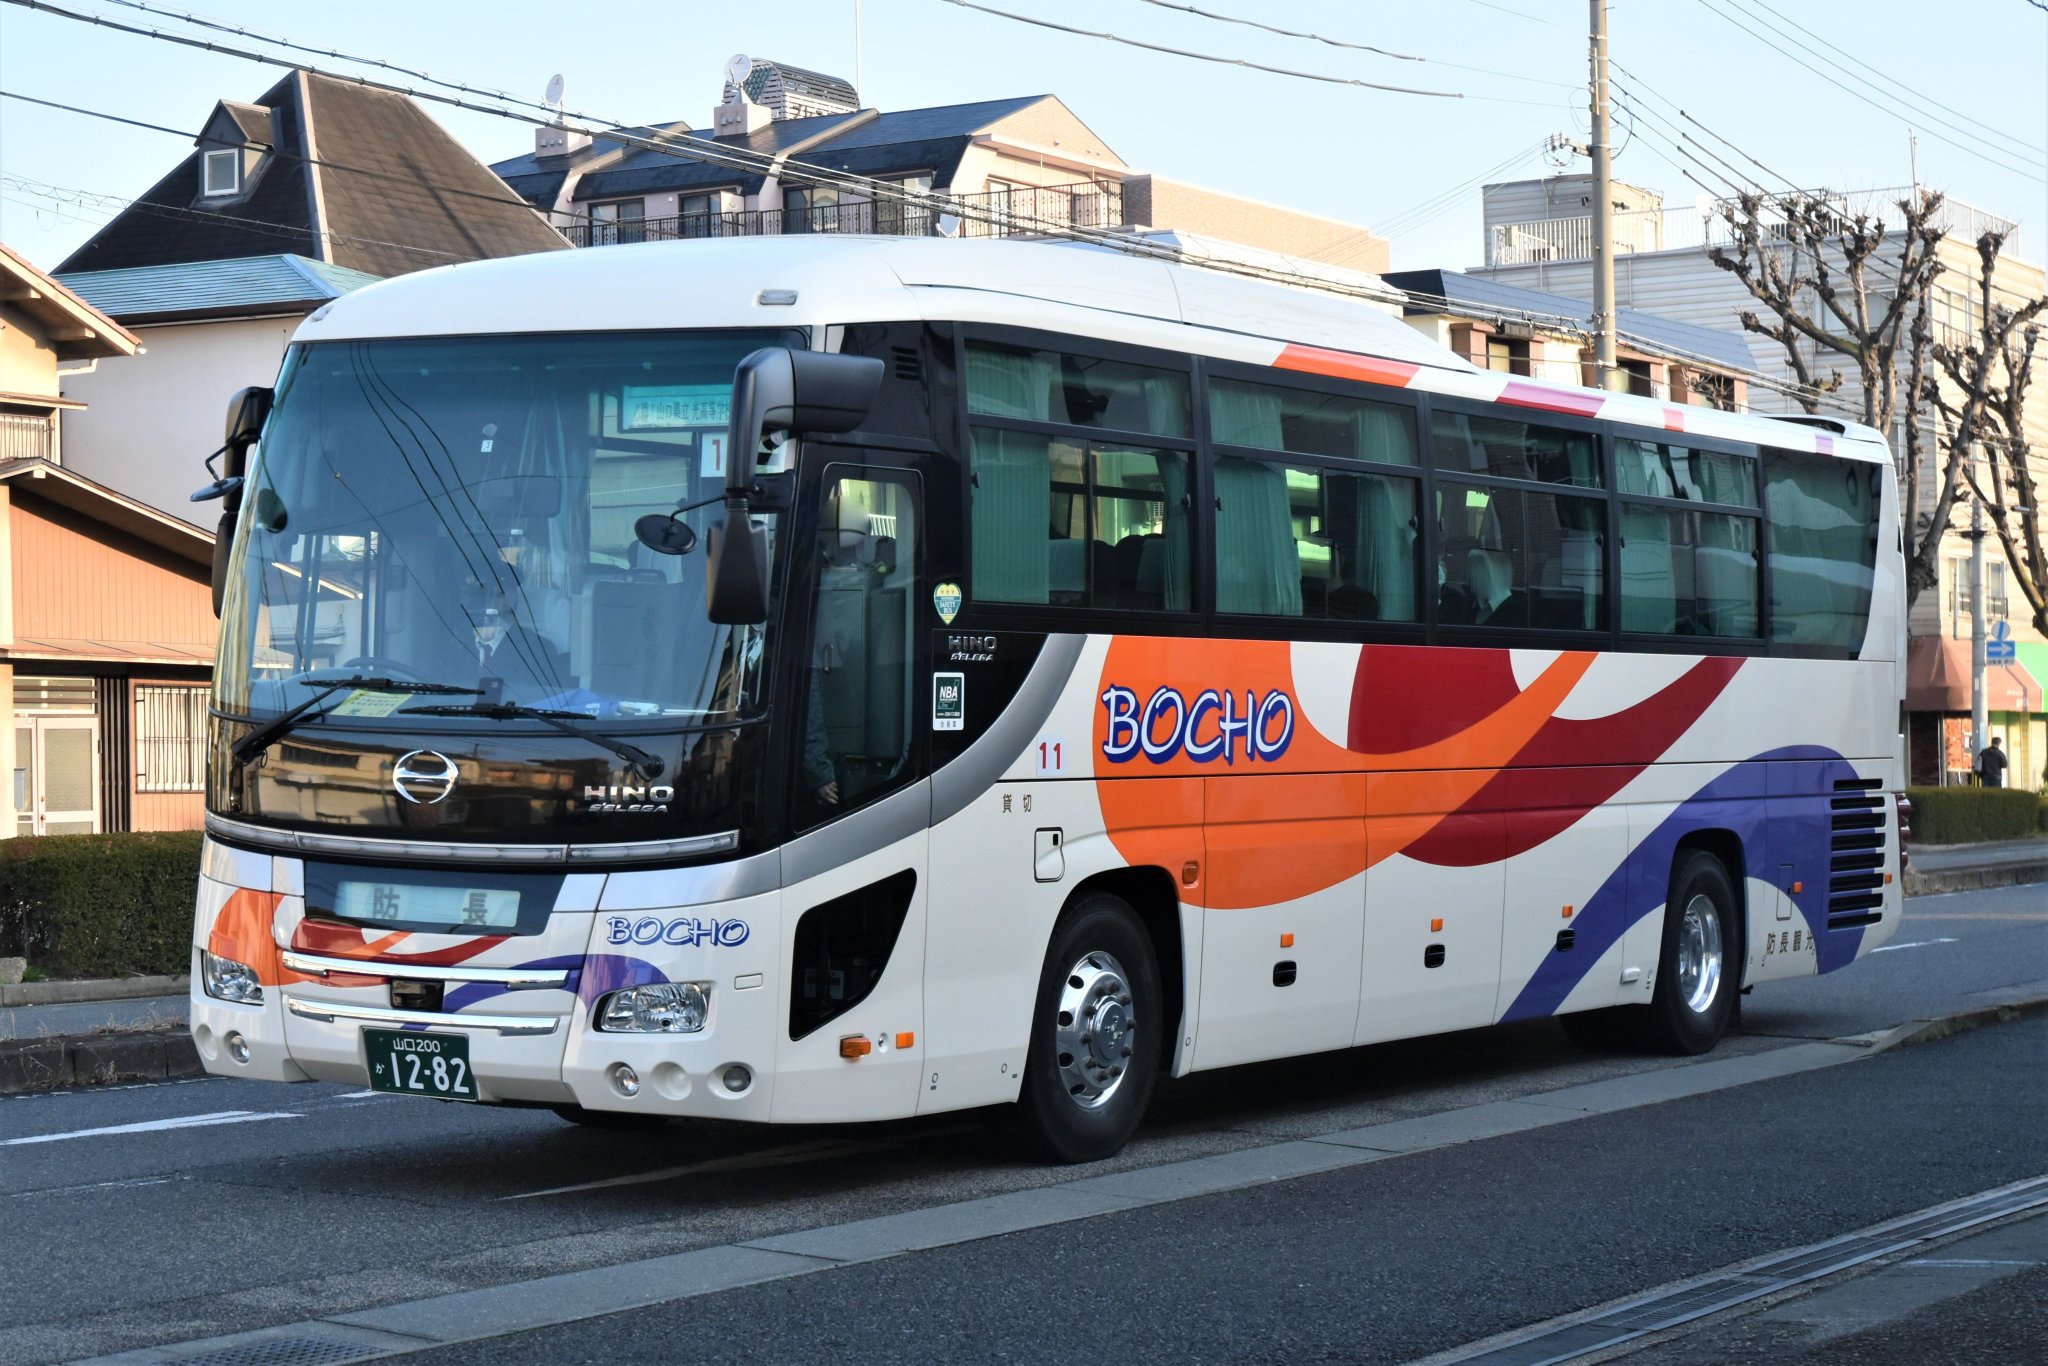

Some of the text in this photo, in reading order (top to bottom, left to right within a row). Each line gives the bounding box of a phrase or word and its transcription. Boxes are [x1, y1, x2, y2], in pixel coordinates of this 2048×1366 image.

[948, 635, 997, 652] HINO
[940, 686, 958, 699] NBA
[1102, 684, 1295, 766] BOCHO
[1039, 742, 1061, 770] 11
[584, 785, 675, 802] HINO
[1002, 793, 1032, 814] 貸切
[606, 916, 750, 947] BOCHO
[375, 1062, 385, 1075] か
[390, 1052, 470, 1094] 12-82
